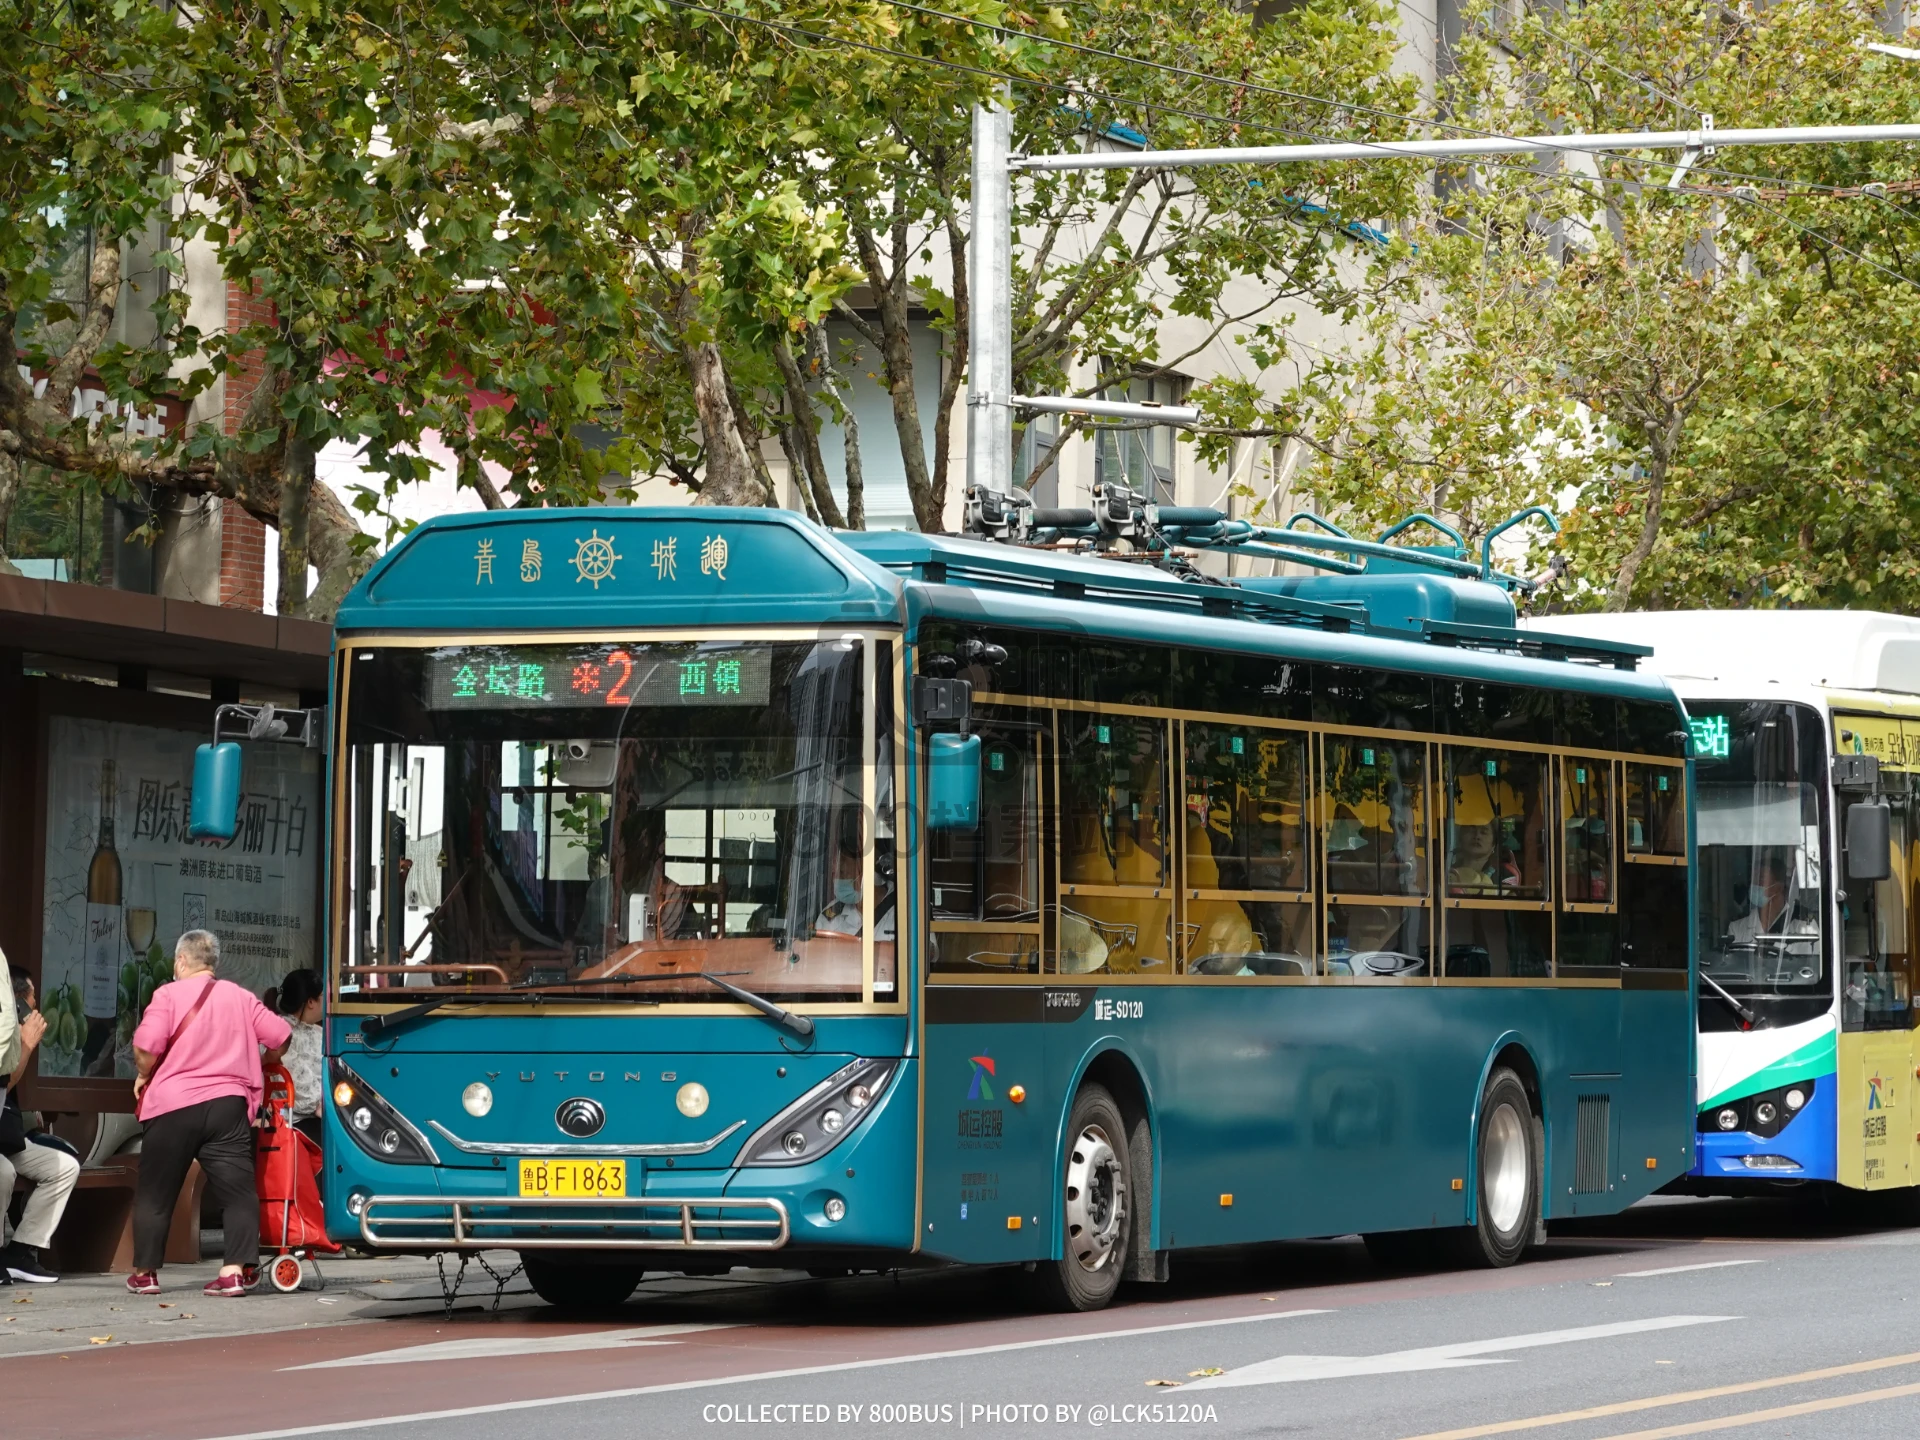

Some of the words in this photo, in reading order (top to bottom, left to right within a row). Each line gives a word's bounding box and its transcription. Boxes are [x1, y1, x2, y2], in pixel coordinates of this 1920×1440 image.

[450, 662, 545, 698] 金坛路
[605, 650, 632, 705] 2
[679, 660, 741, 696] 西镇
[179, 857, 262, 884] 澳洲原装进口葡萄酒
[1094, 999, 1144, 1021] 城运-SD120
[485, 1071, 677, 1082] YUTONG
[957, 1109, 1003, 1138] 城运控股
